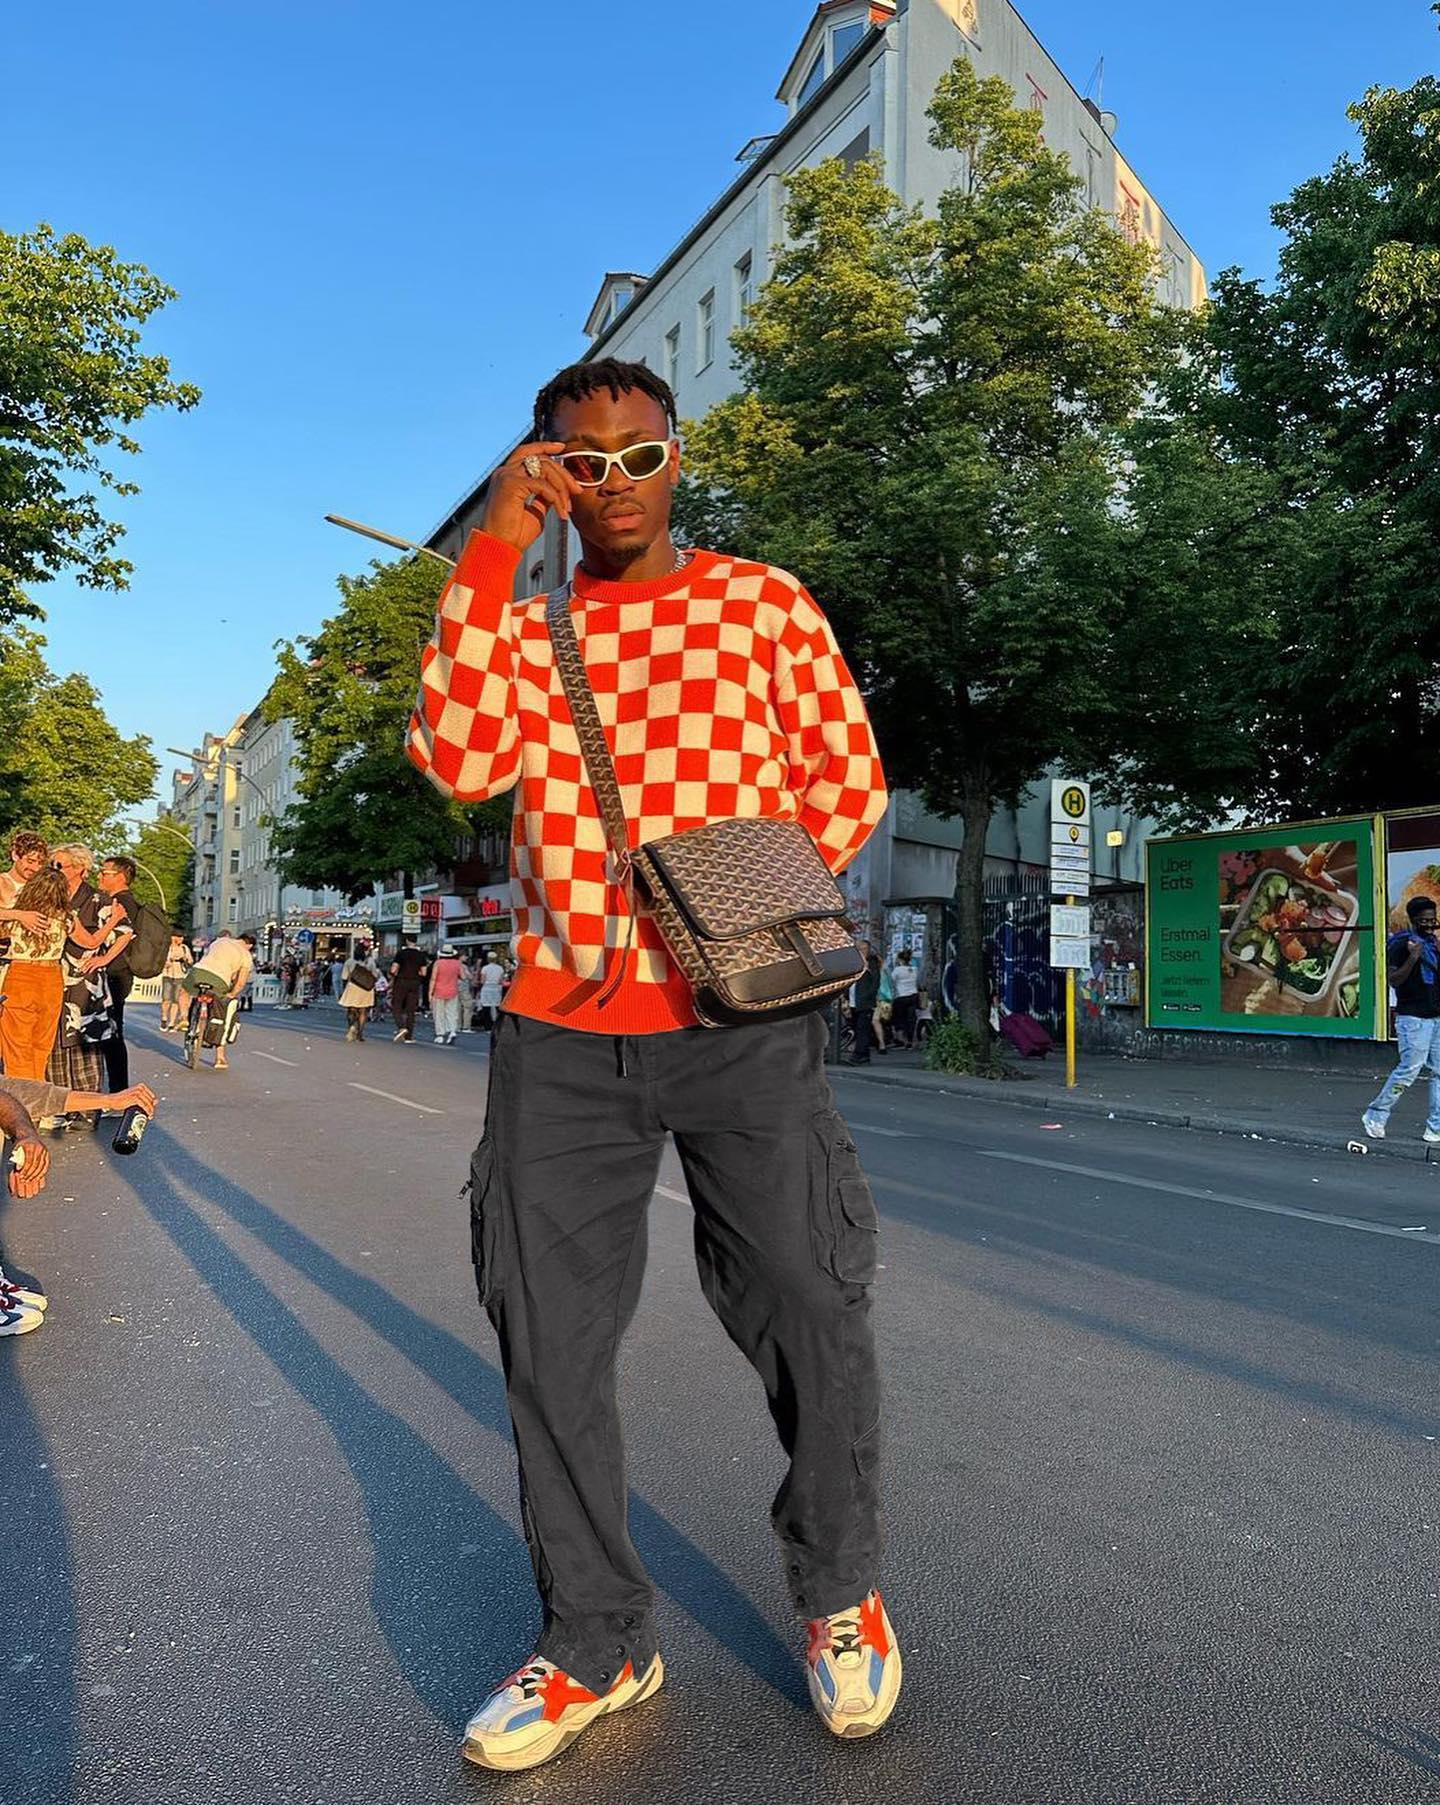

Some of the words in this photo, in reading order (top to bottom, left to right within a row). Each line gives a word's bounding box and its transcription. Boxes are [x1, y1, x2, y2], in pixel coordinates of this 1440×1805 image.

[1069, 793, 1080, 811] H
[1160, 855, 1193, 873] Uber
[1160, 875, 1194, 891] Eats
[1160, 926, 1210, 942] Erstmal
